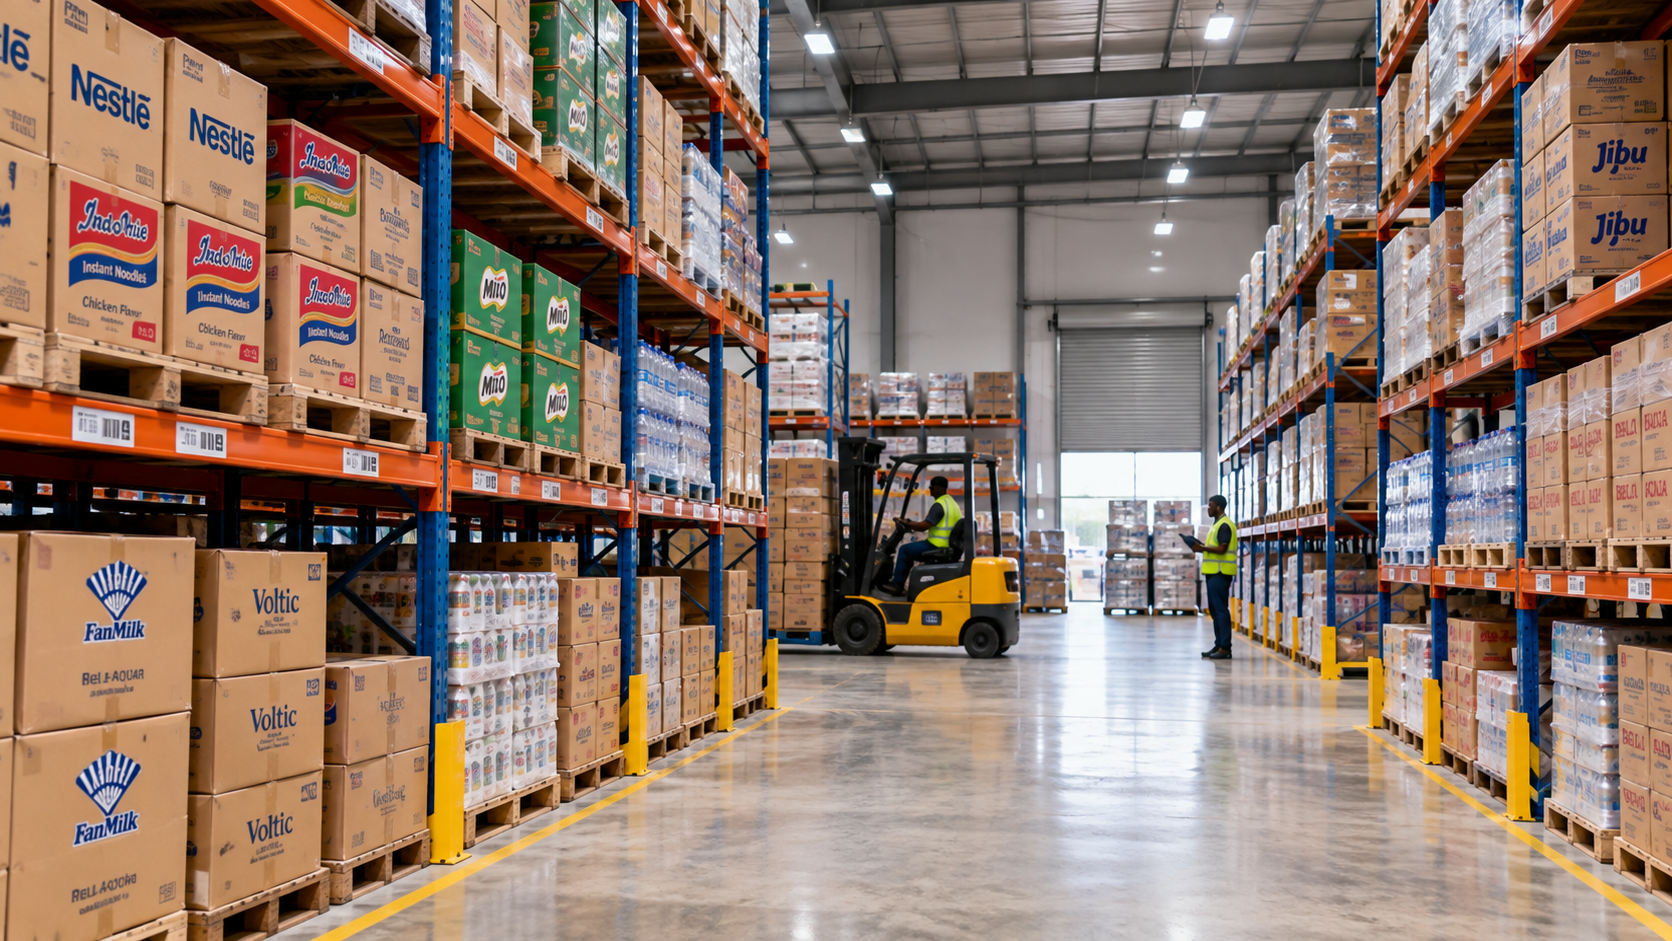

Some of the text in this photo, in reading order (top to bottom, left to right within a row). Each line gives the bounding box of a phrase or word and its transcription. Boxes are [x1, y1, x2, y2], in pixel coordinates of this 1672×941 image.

[1592, 139, 1648, 175] Jibu
[1590, 210, 1648, 247] Jibu
[82, 260, 147, 284] Instant Noodles
[82, 296, 118, 314] Chicken
[252, 587, 300, 615] Voltic
[83, 619, 146, 643] FanMilk
[250, 704, 298, 733] Voltic
[73, 811, 139, 846] FanMilk
[247, 812, 294, 844] Voltic
